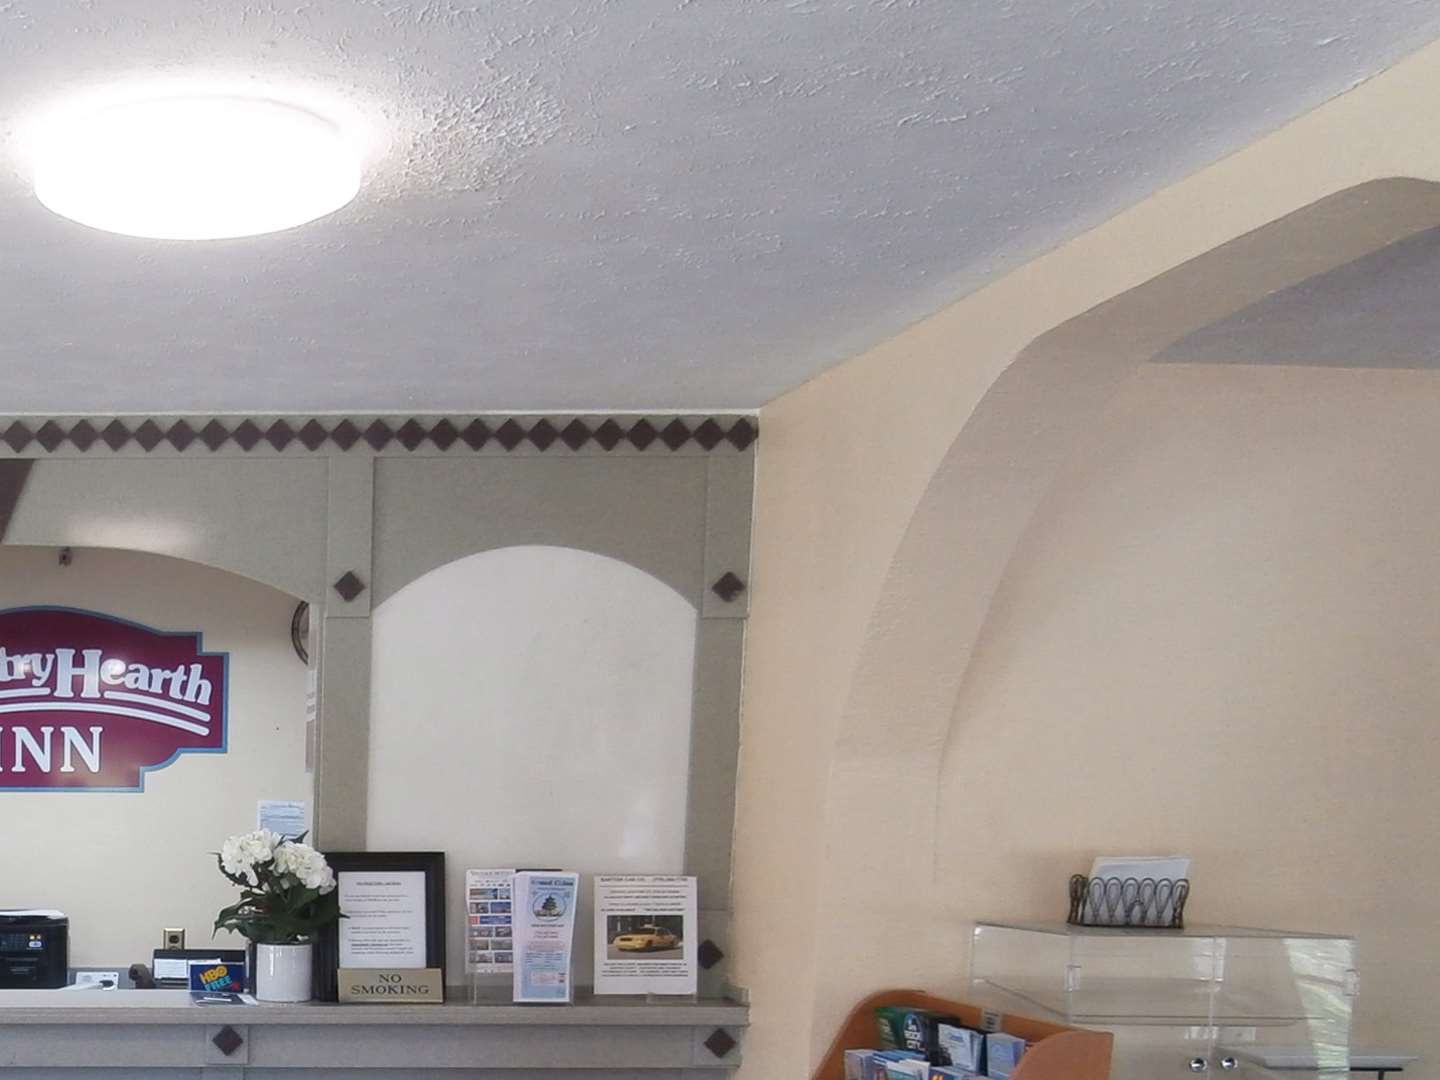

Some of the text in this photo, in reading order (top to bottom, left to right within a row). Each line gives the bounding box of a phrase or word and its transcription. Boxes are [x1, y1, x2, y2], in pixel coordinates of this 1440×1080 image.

[54, 648, 212, 705] Hearth
[199, 965, 228, 984] HBO
[378, 973, 402, 983] NO
[351, 984, 430, 995] SMOKING
